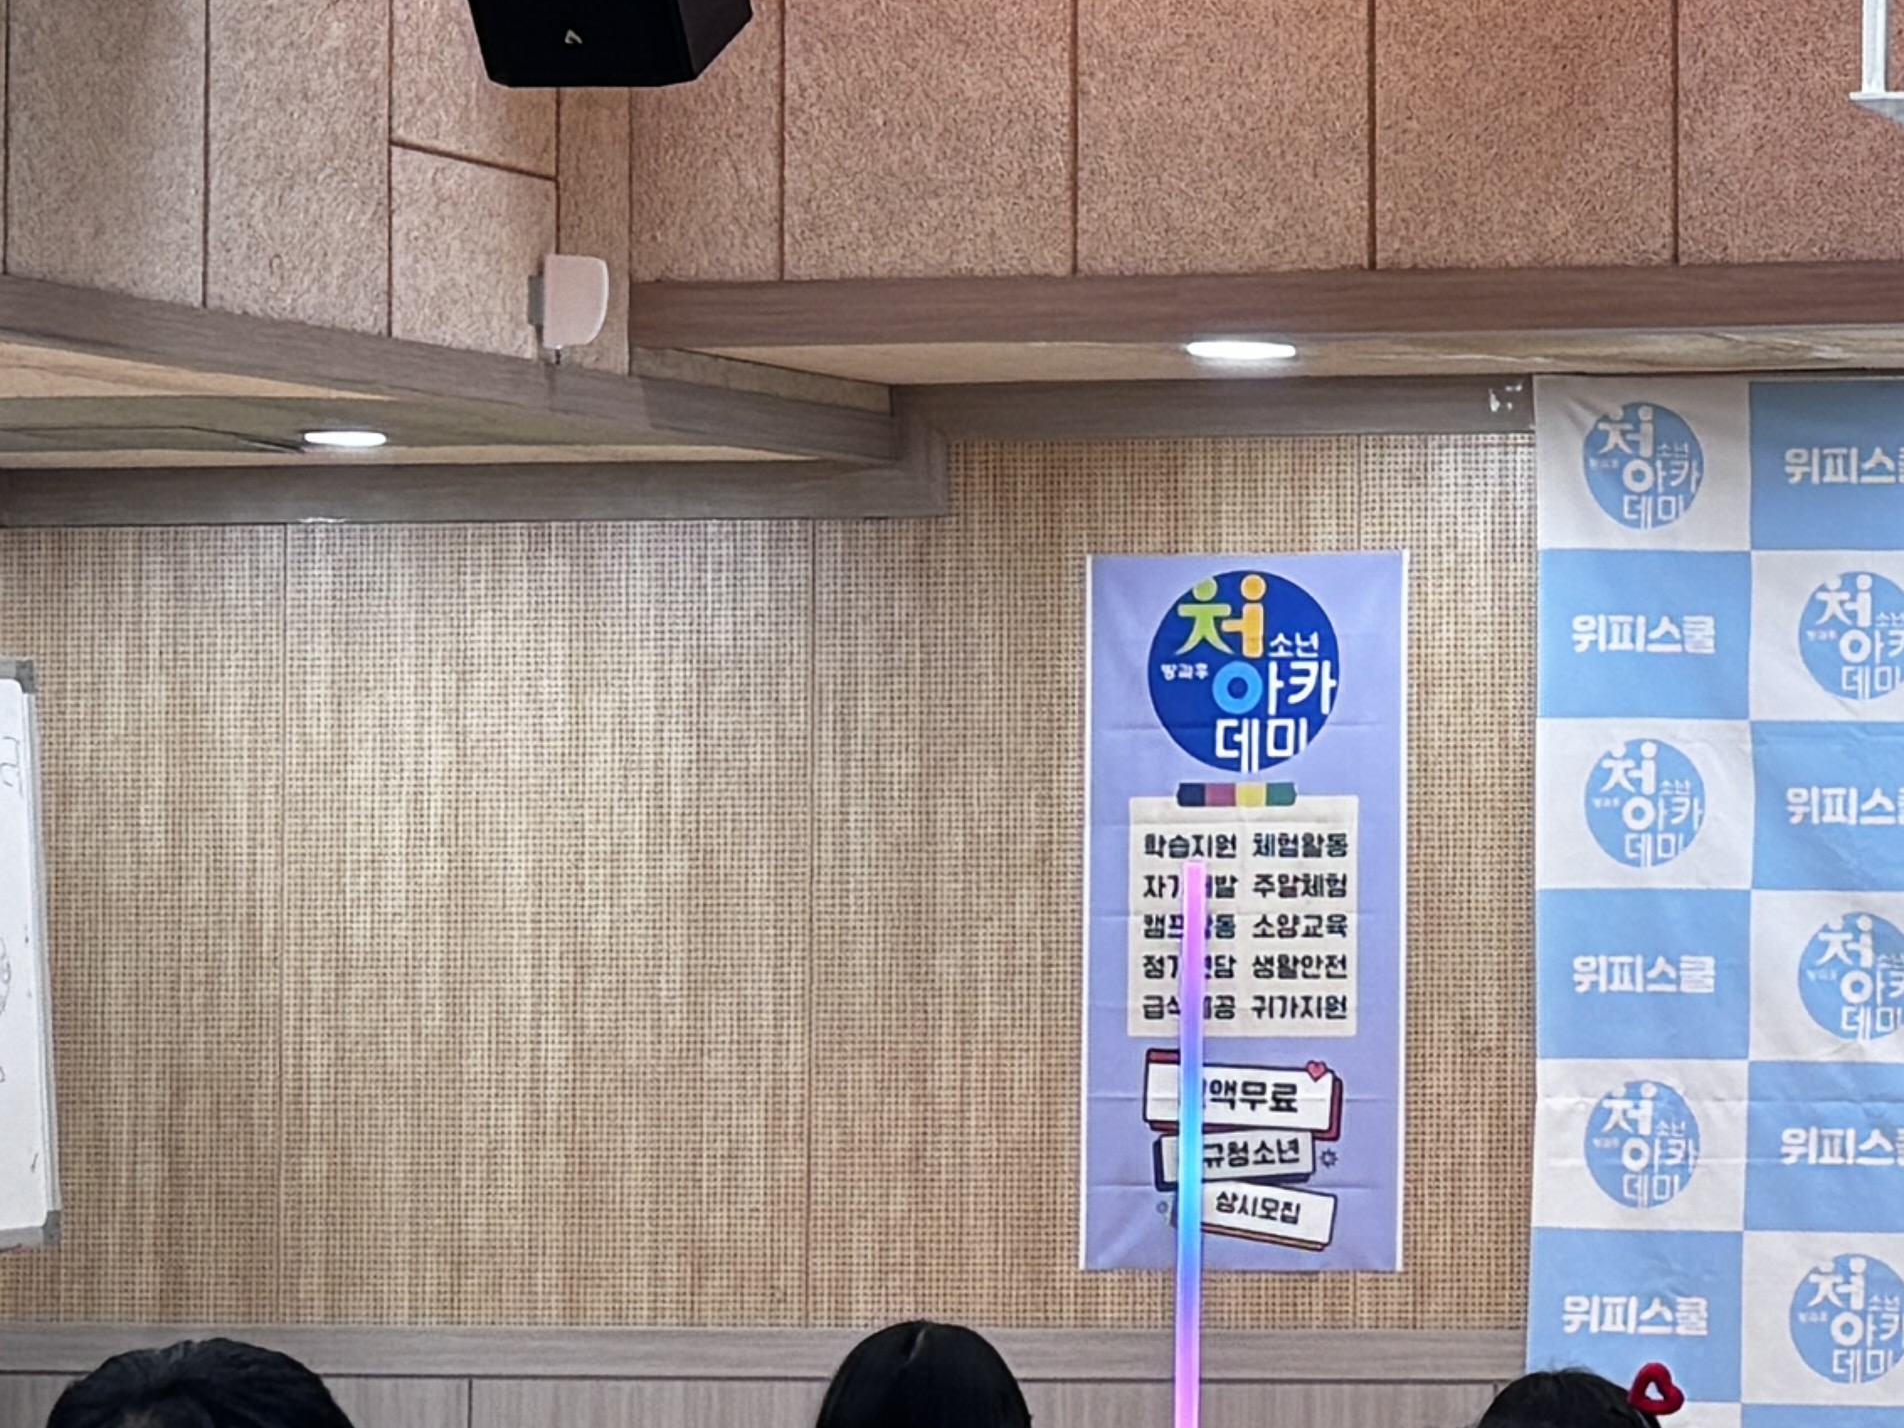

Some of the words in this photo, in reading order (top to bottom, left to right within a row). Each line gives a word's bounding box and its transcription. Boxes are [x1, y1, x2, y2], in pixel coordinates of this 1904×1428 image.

[1573, 615, 1715, 654] 위피스쿨
[1143, 832, 1237, 859] 학습지원
[1252, 832, 1348, 858] 체험활동
[1252, 873, 1347, 899] 주말체험
[1143, 913, 1236, 939] 캠프동
[1252, 913, 1347, 938] 소양교육
[1252, 954, 1348, 979] 생활안전
[1573, 956, 1715, 993] 위피스쿨
[1251, 994, 1348, 1020] 귀가지원
[1203, 1078, 1298, 1113] 액무료
[1215, 1191, 1301, 1225] 상시모집
[1564, 1296, 1708, 1336] 위피스쿨
